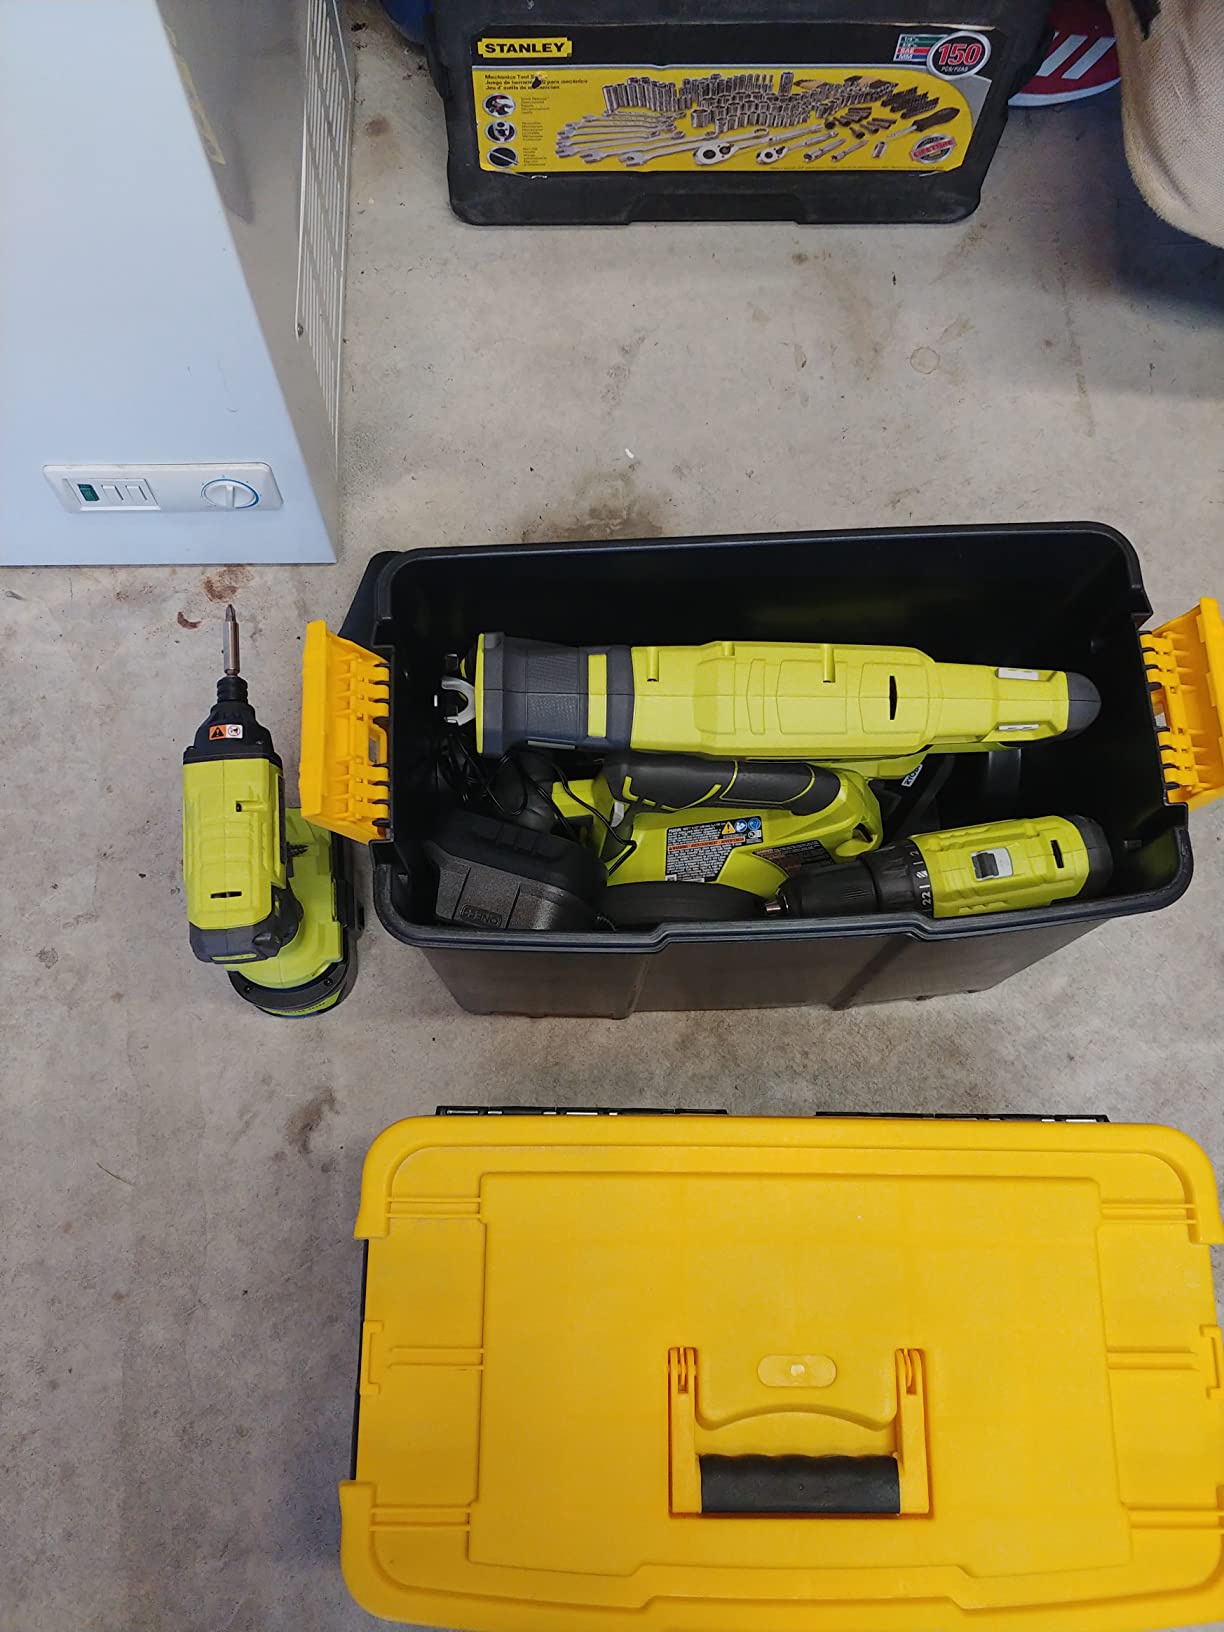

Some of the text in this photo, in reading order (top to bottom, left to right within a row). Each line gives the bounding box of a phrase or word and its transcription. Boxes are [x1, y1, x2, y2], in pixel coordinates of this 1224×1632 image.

[485, 42, 565, 53] STANLEY
[938, 43, 982, 65] 150
[921, 891, 931, 905] 22
